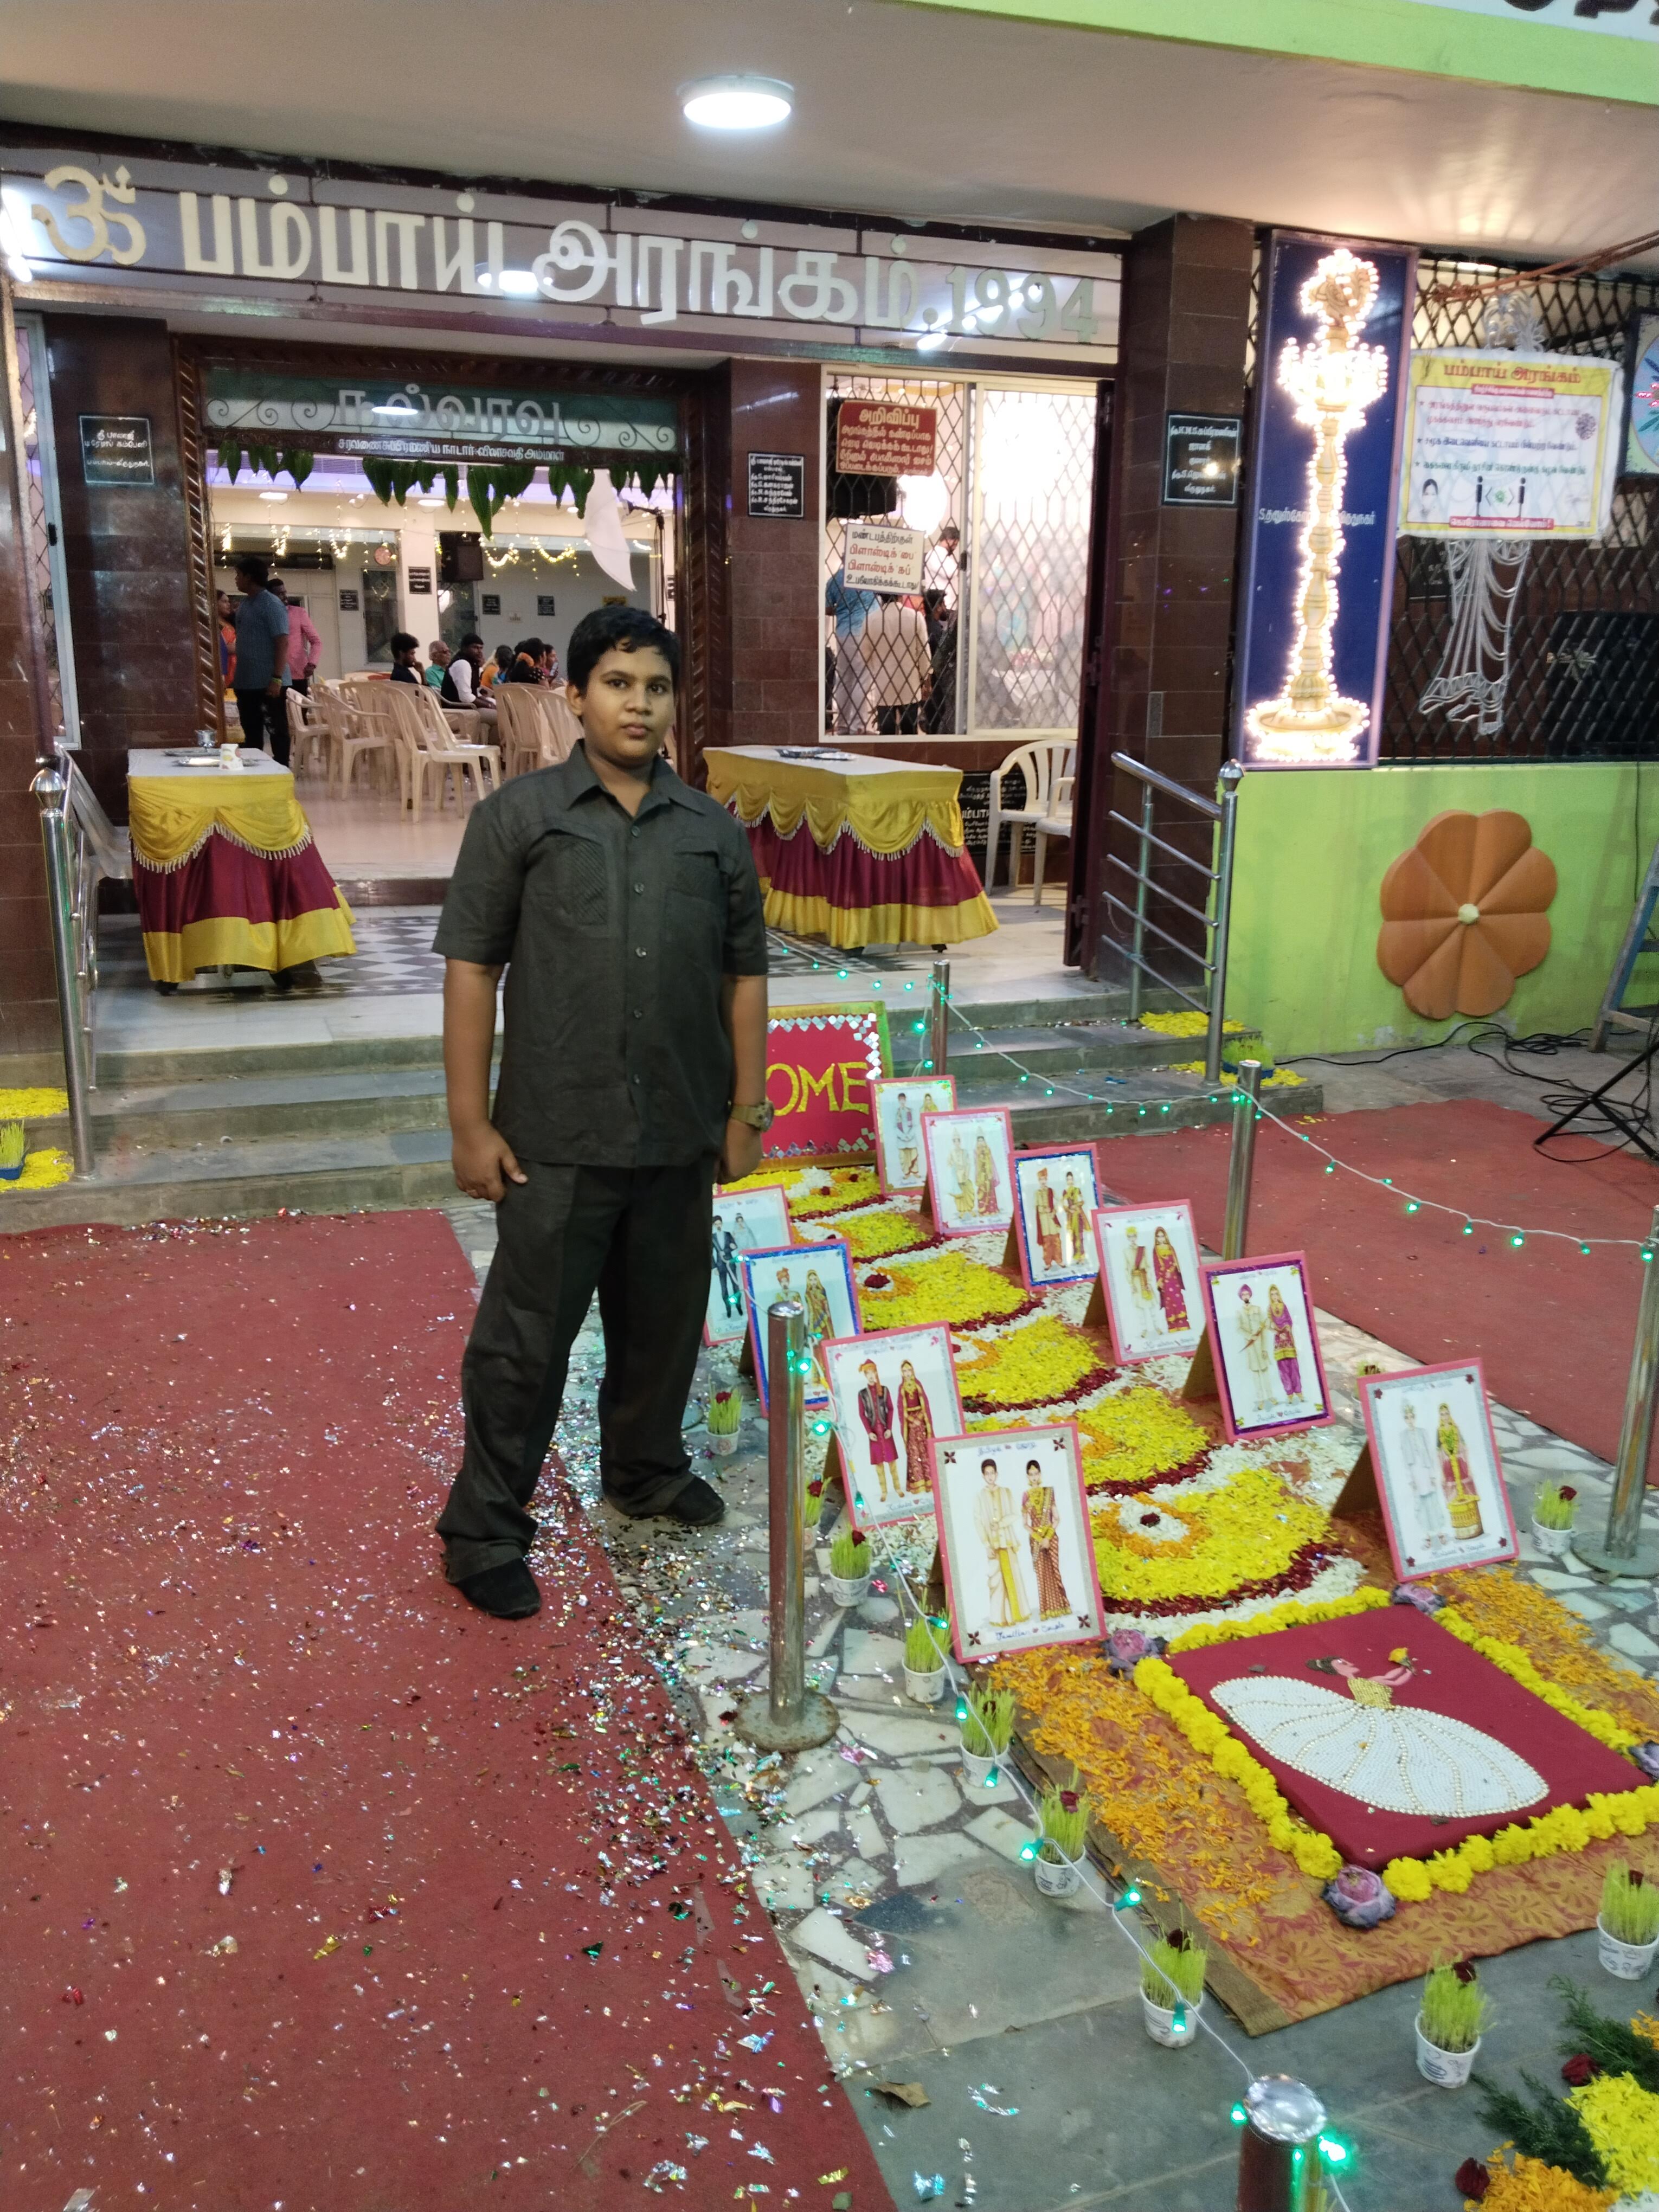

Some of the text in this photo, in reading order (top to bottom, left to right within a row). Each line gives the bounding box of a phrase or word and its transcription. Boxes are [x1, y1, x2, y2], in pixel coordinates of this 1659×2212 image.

[179, 175, 504, 297] பம்பாய்
[1444, 359, 1581, 384] பம்பாய் அரங்கம்
[859, 407, 919, 429] அறிவிப்பு
[852, 528, 914, 545] மண்டபத்திற்குள்
